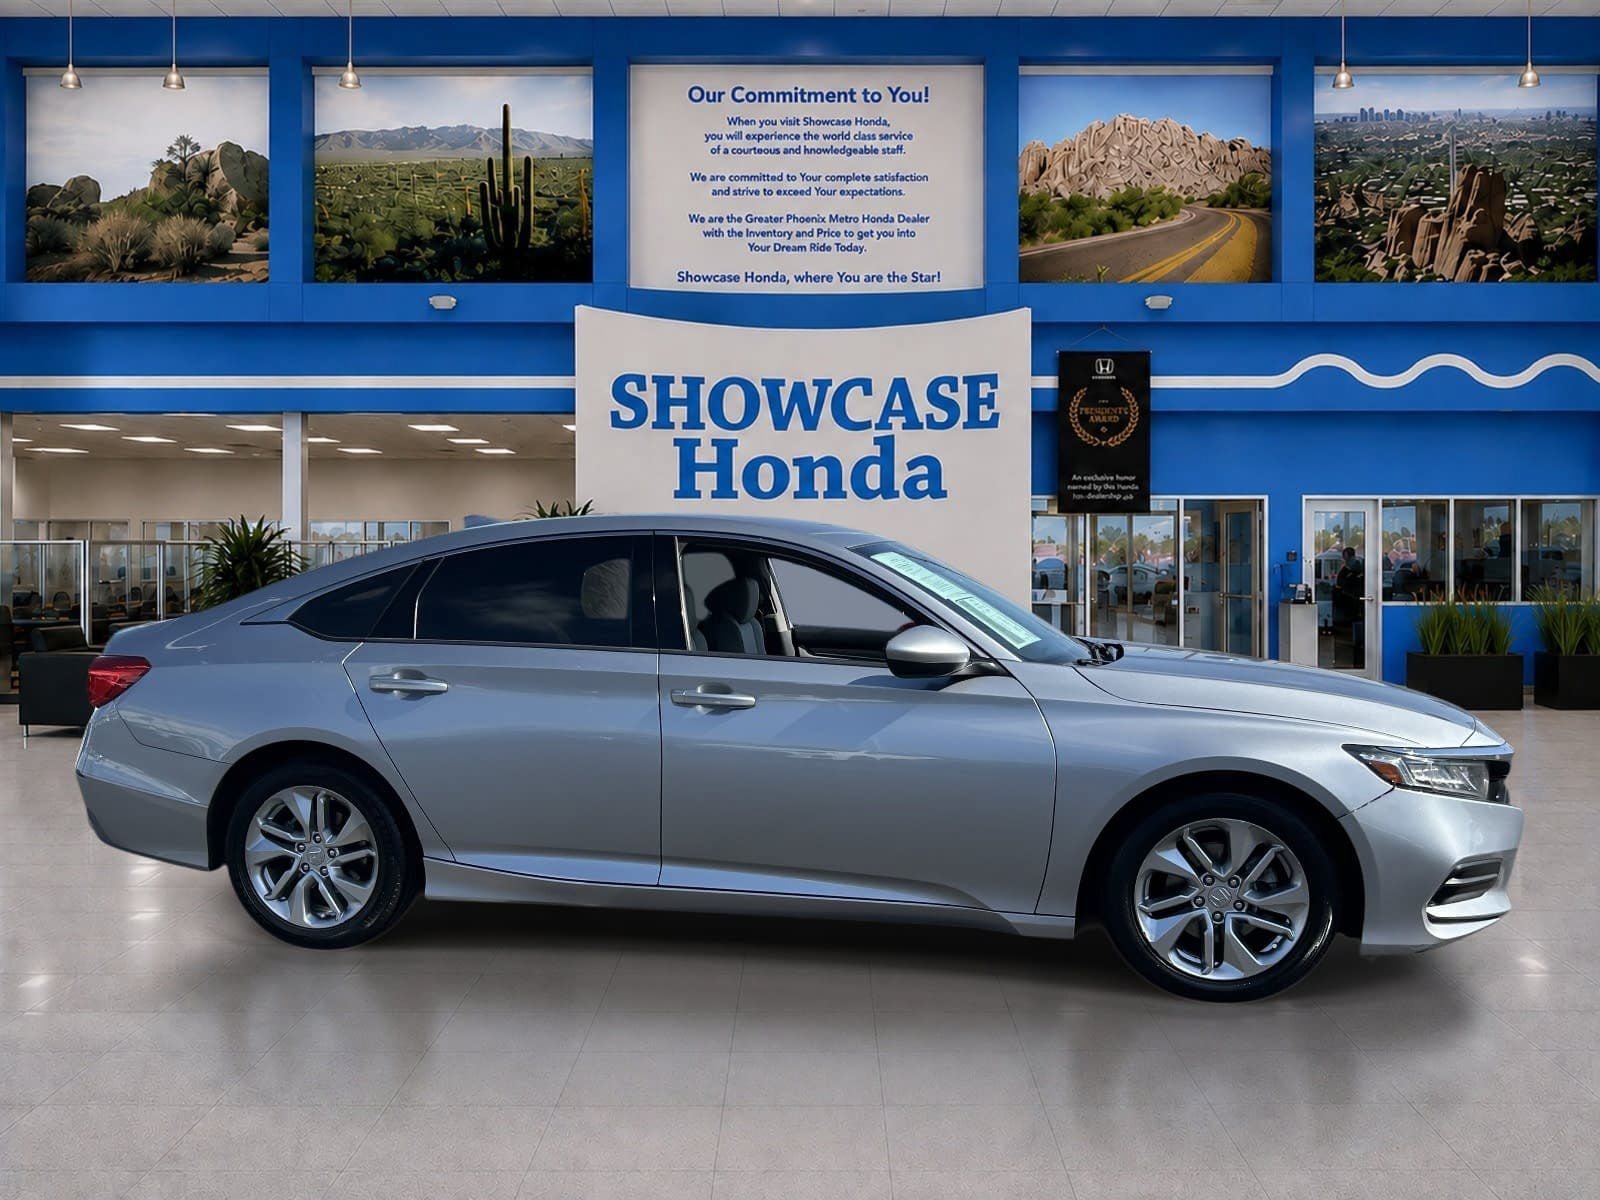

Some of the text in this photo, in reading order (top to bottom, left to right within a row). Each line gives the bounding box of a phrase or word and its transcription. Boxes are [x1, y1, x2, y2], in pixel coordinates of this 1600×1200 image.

[687, 85, 930, 104] Our Commitment to You!
[726, 115, 891, 129] When you visit Showcase Honda,
[704, 130, 914, 144] you will experience the world class service
[709, 144, 722, 155] of
[722, 147, 730, 155] a
[730, 146, 781, 156] courteous
[782, 144, 802, 155] and
[881, 144, 907, 156] staff.
[689, 171, 929, 185] We are committed to Your complete satisfaction
[711, 185, 906, 200] and strive to exceed Your expectations.
[688, 212, 931, 224] We are the Greater Phoenix Metro Honda Dealer
[702, 227, 917, 241] with the Inventory and Price to get you into
[747, 241, 868, 255] Your Dream Ride Today.
[676, 270, 941, 286] Showcase Honda, where You are the Star!
[610, 373, 1001, 431] SHOWCASE
[673, 434, 948, 500] Honda
